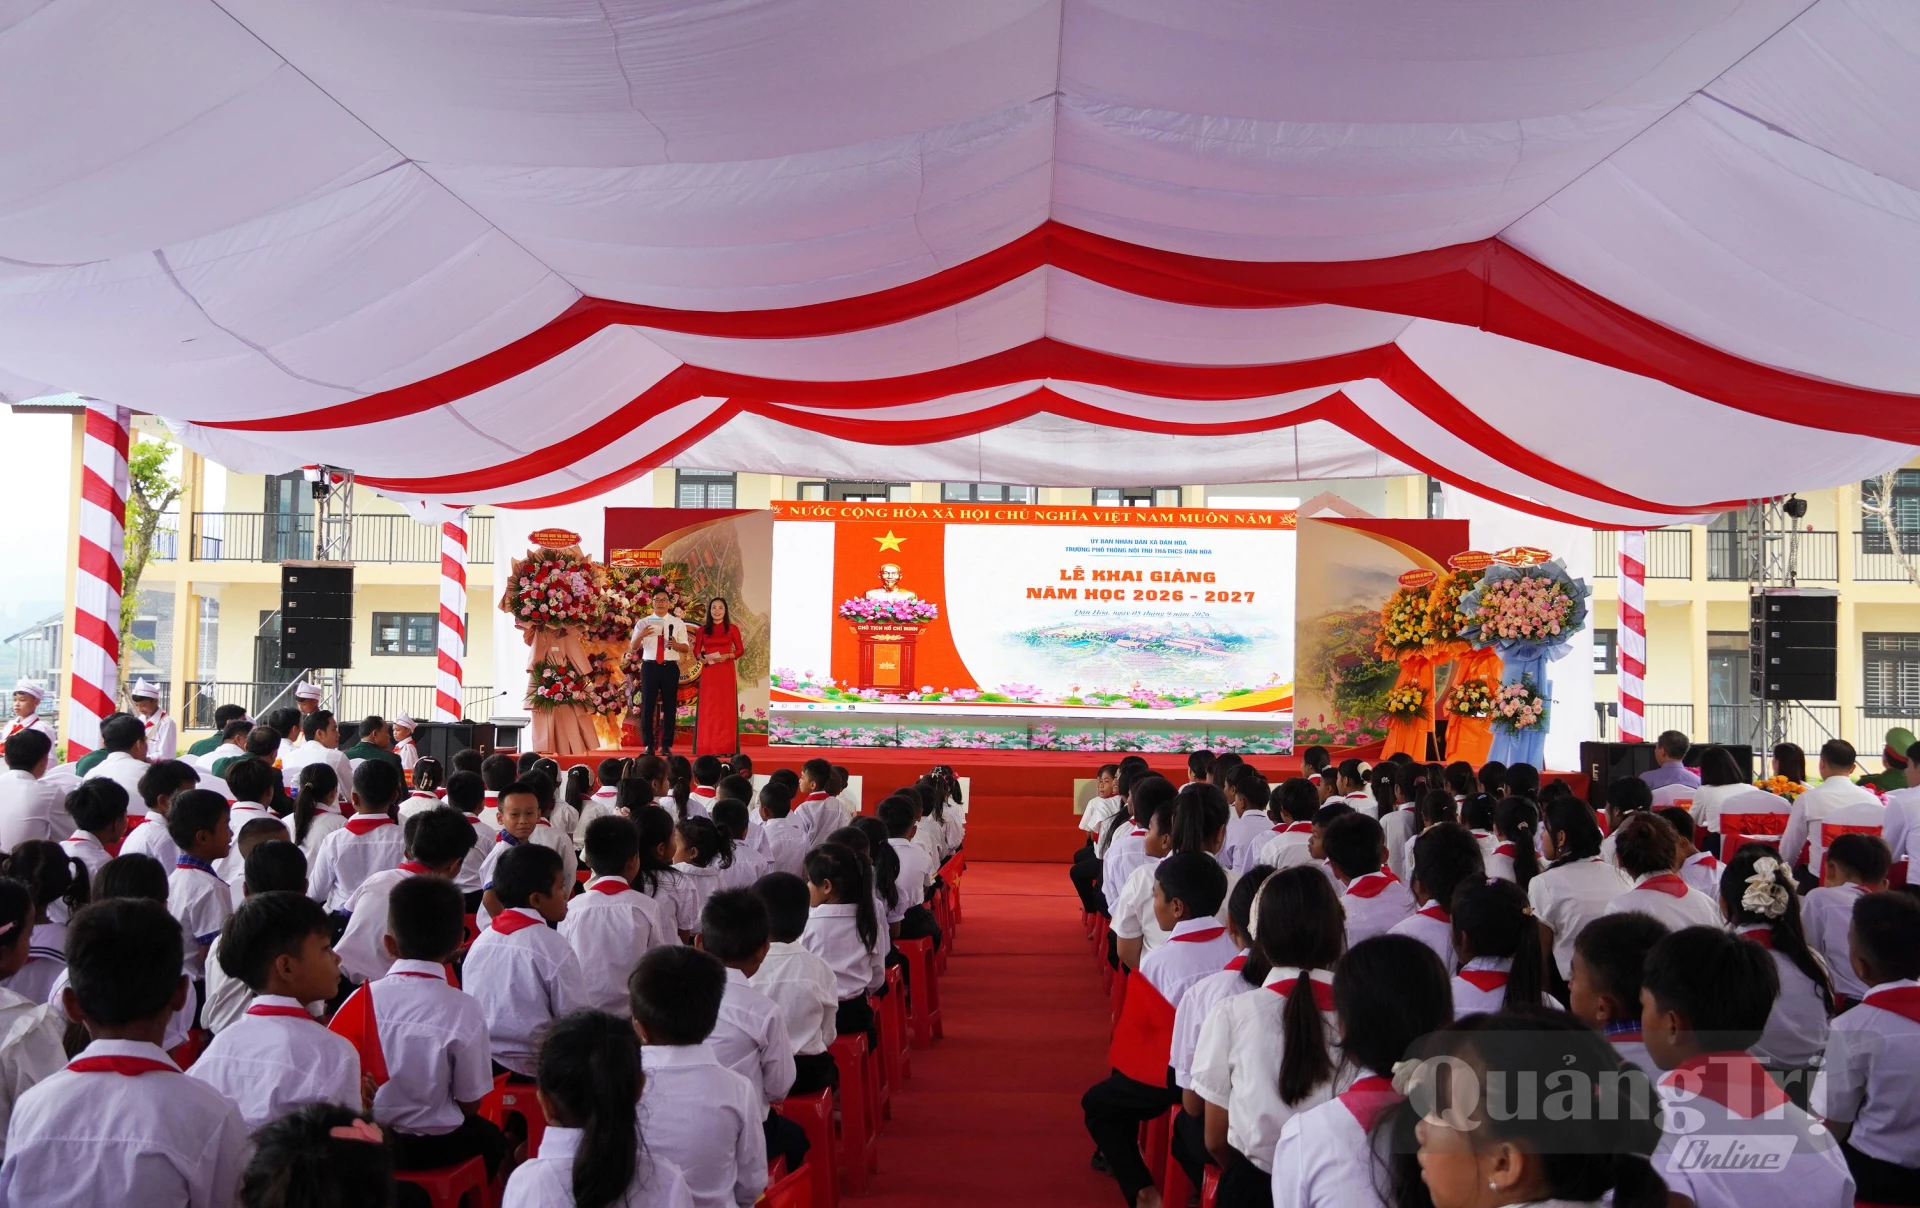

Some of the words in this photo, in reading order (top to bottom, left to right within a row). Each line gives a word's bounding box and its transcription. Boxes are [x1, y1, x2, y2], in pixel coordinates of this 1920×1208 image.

[790, 505, 836, 517] NƯỚC
[840, 507, 888, 519] CỘNG
[893, 506, 927, 518] HÒA
[932, 507, 955, 519] XÃ
[960, 508, 990, 521] HỘI
[995, 508, 1029, 520] CHỦ
[1034, 509, 1088, 521] NGHĨA
[1093, 510, 1132, 524] VIỆT
[1136, 512, 1174, 523] NAM
[1179, 511, 1229, 524] MUÔN
[1234, 511, 1272, 525] NĂM
[1060, 565, 1085, 581] LỄ
[1092, 570, 1143, 582] KHAI
[1150, 568, 1216, 583] GIẢNG
[1026, 586, 1077, 600] NĂM
[1084, 588, 1125, 603] HỌC
[1133, 589, 1184, 601] 2026
[1205, 591, 1255, 603] 2027
